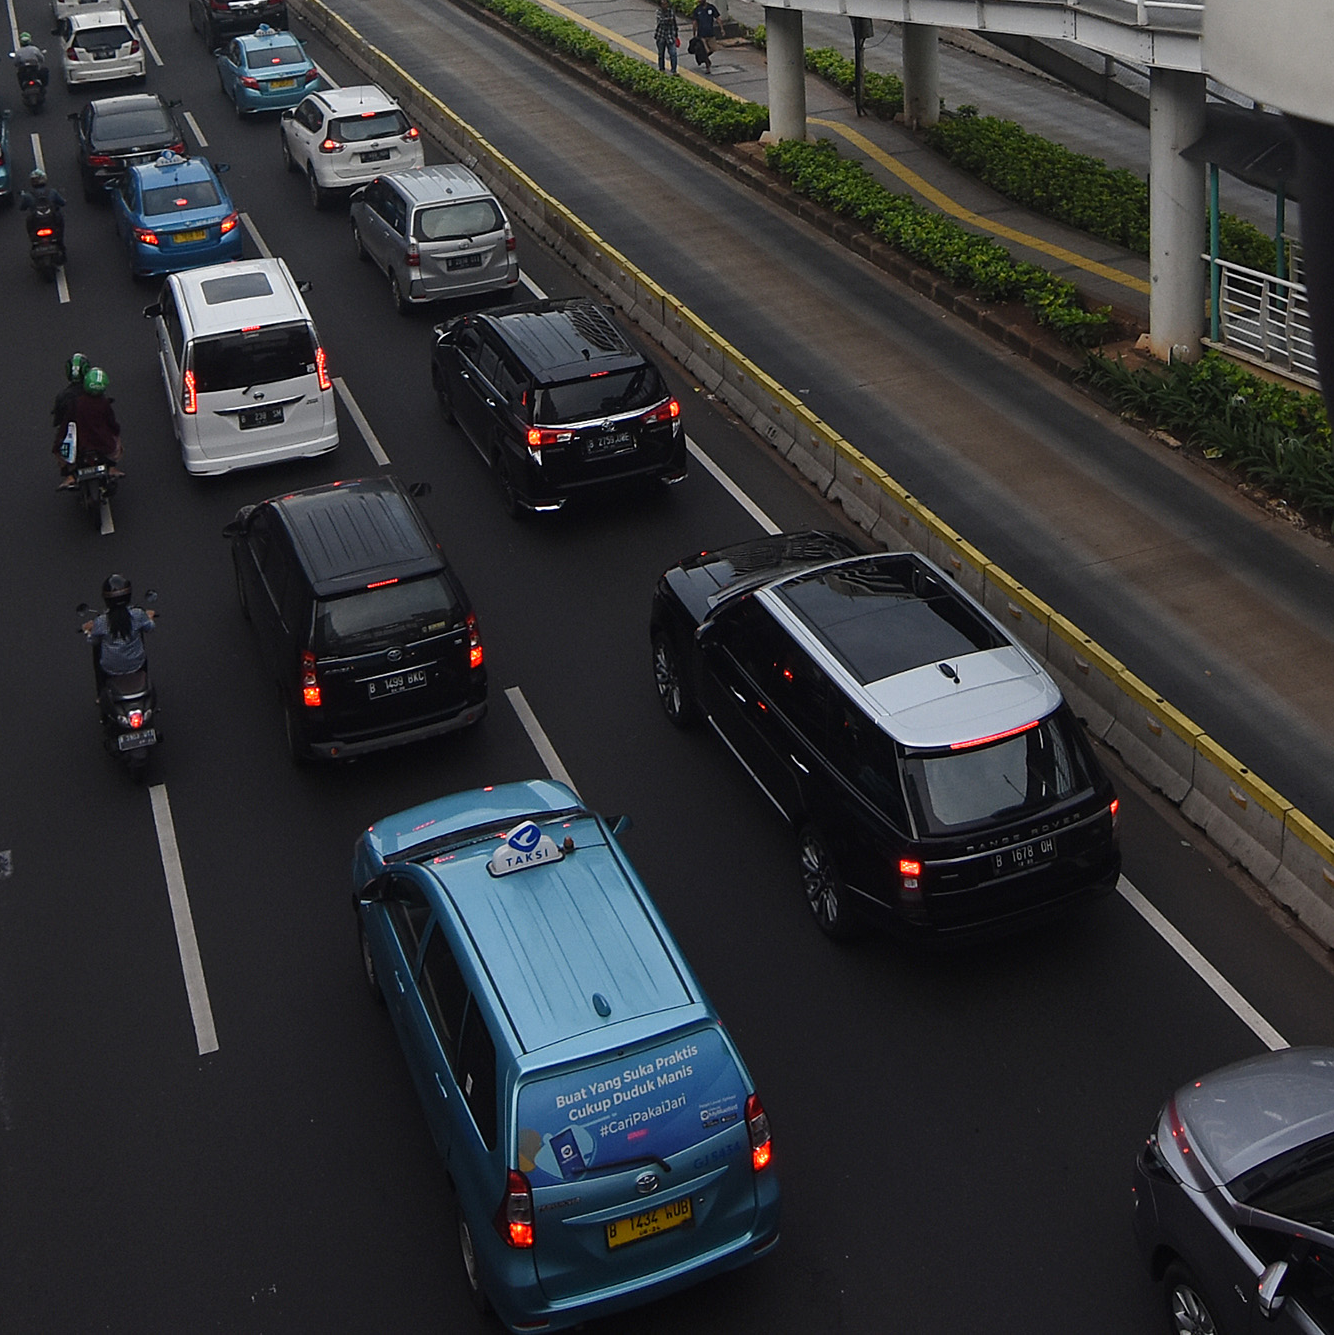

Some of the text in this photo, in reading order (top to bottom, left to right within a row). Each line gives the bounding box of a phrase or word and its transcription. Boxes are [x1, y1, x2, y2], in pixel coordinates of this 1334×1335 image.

[370, 683, 376, 694] B
[384, 676, 404, 689] 1499
[1031, 813, 1081, 836] ROVER
[505, 850, 550, 868] TAKSI
[996, 854, 1003, 868] B
[1012, 845, 1034, 863] 1678
[555, 1044, 698, 1109] Buat Yang Suka Praktis
[568, 1063, 694, 1121] Cukup Duduk Manis
[599, 1092, 687, 1138] #CariPakaiJari
[609, 1223, 617, 1238] B
[629, 1215, 658, 1231] 1434
